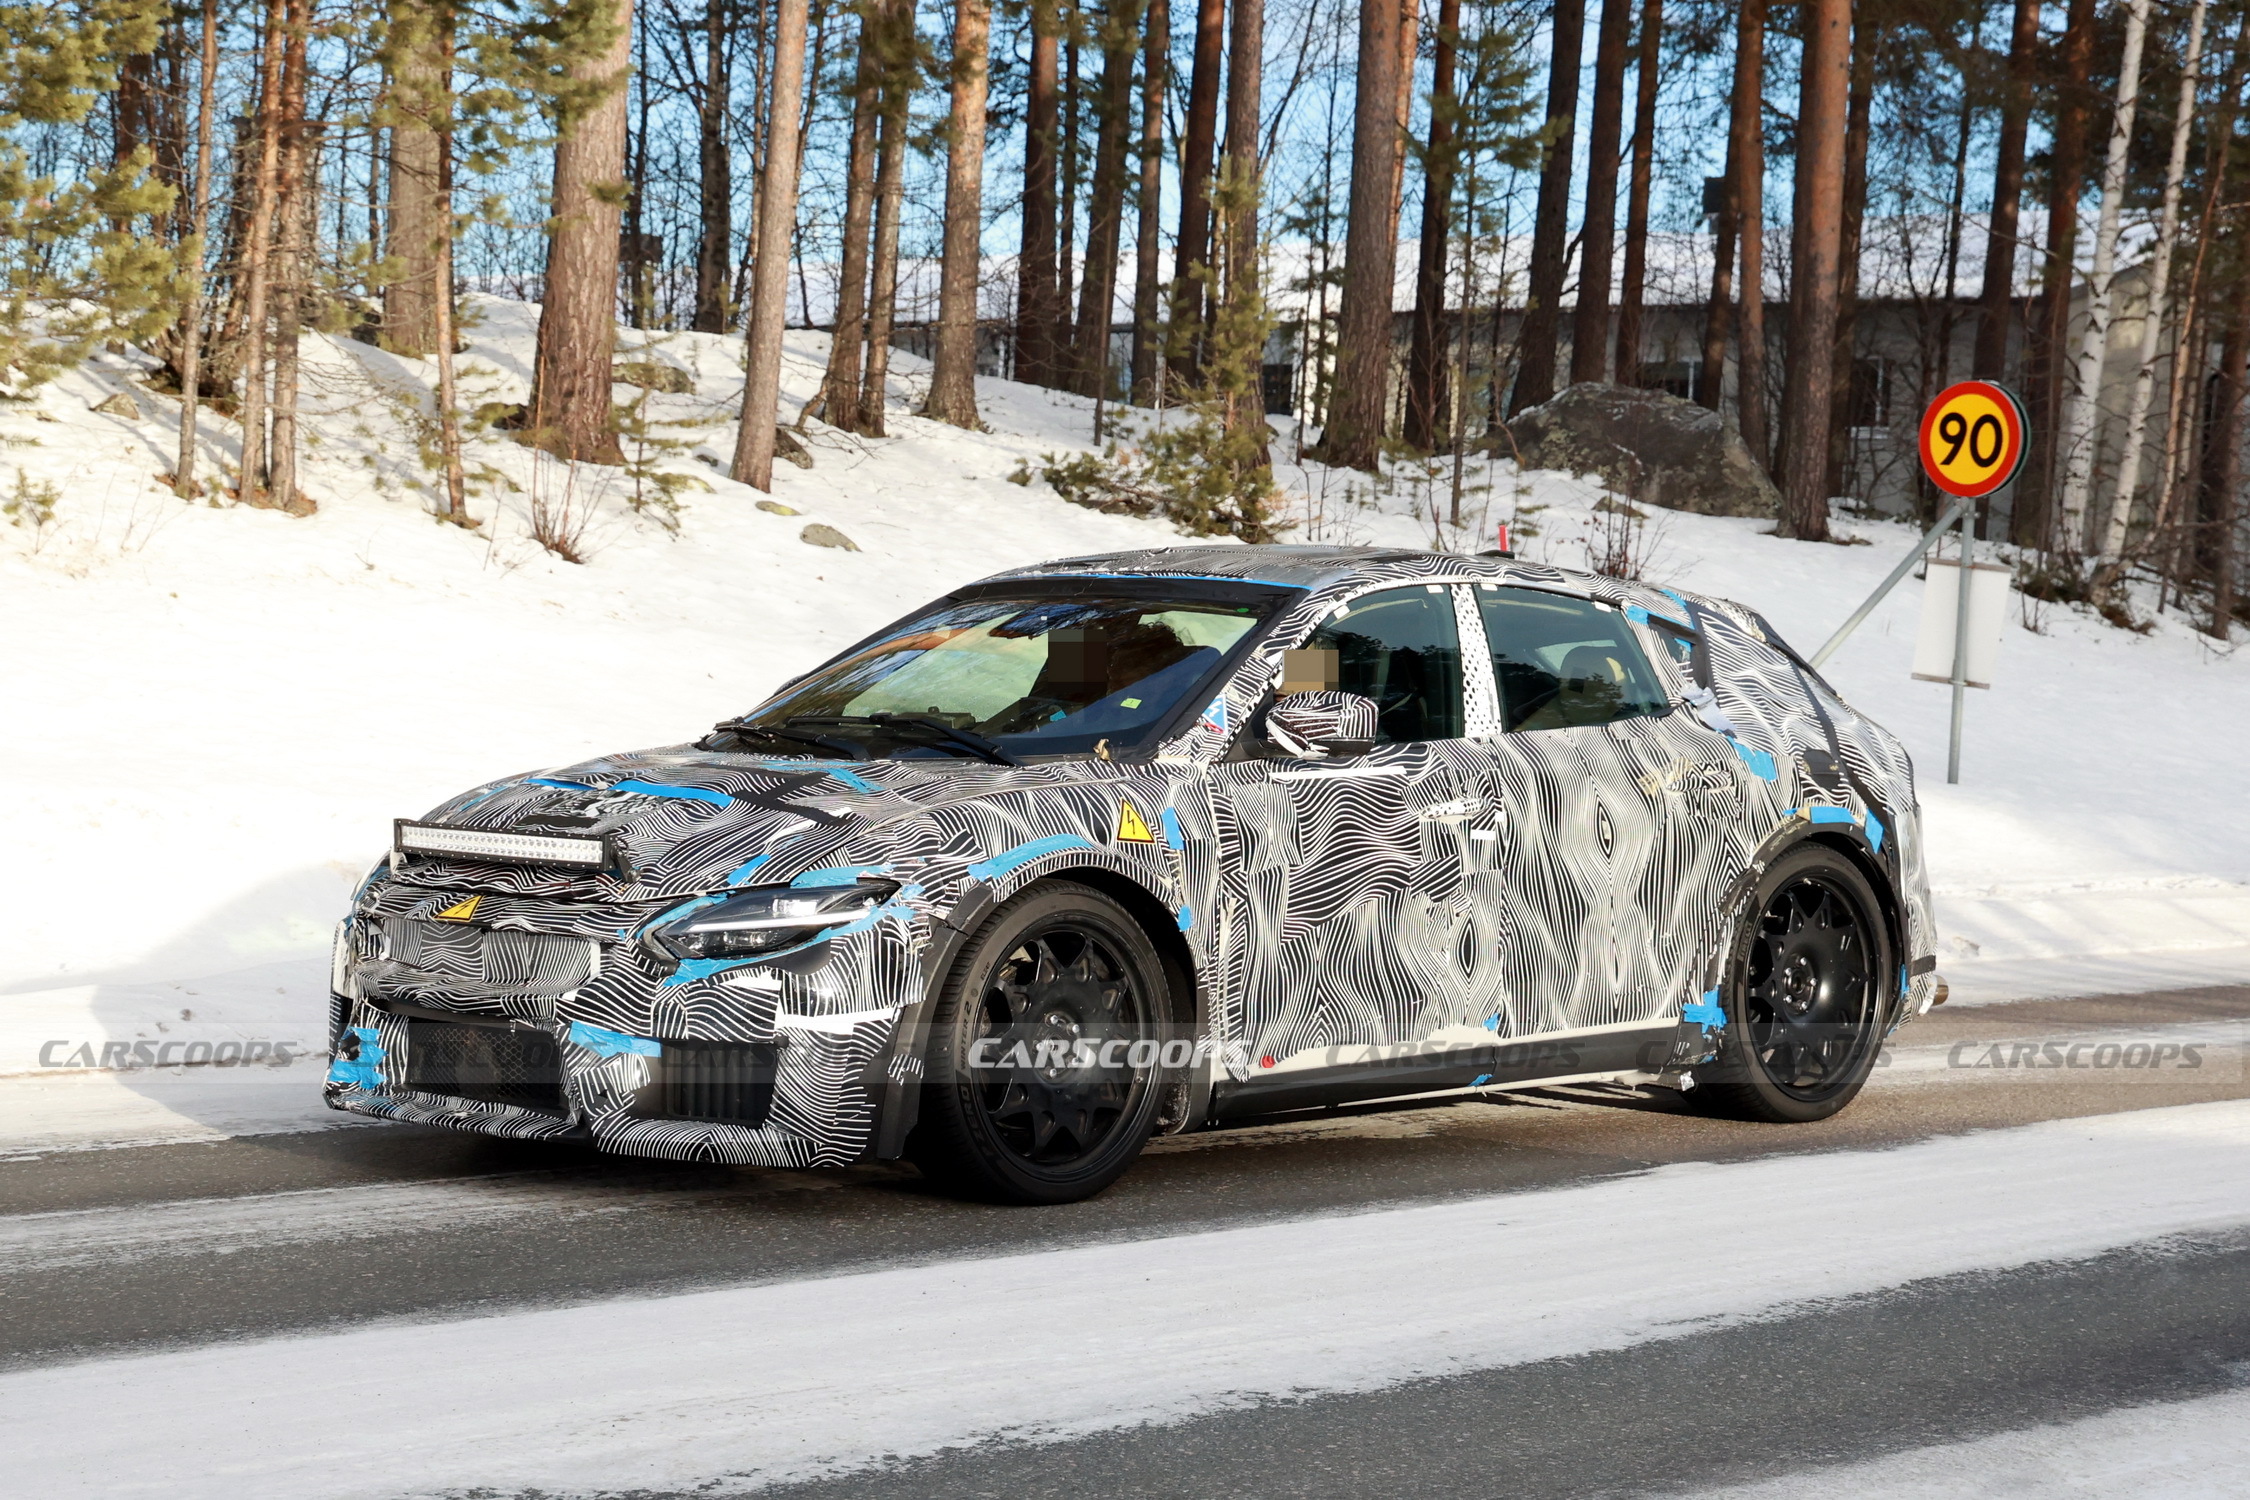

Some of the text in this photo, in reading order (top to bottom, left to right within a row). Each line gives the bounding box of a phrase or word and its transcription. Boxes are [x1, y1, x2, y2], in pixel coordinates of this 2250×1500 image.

[1939, 412, 2003, 467] 90
[964, 1001, 972, 1016] 2
[960, 1019, 968, 1070] WINTER
[960, 1084, 985, 1142] ZERO
